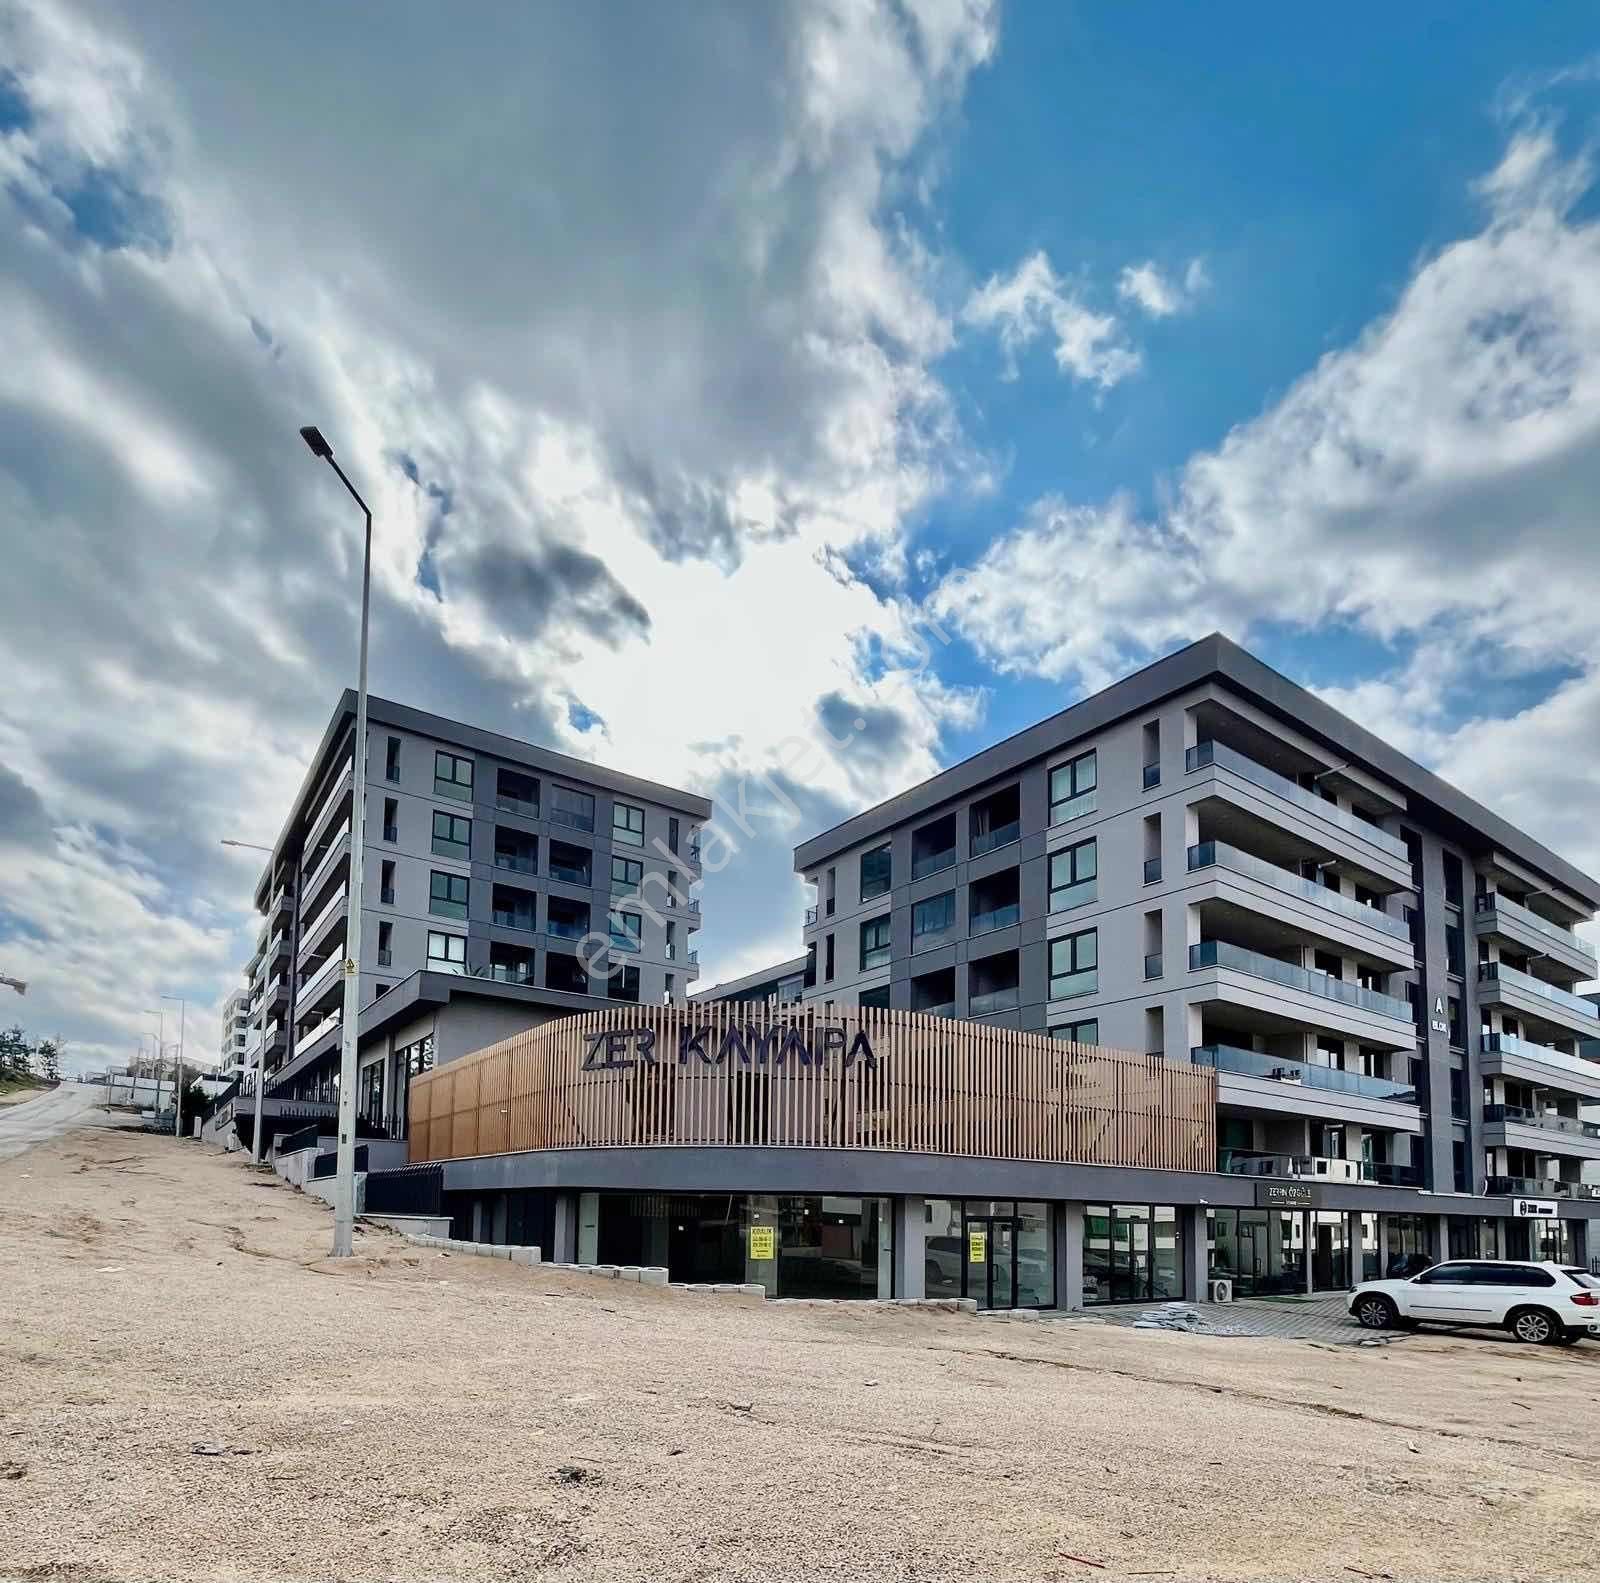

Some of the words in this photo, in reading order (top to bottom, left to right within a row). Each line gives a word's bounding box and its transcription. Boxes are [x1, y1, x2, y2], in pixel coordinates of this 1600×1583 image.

[1435, 997, 1443, 1014] A
[581, 1027, 656, 1072] ZER
[678, 1023, 877, 1069] KAYAPA
